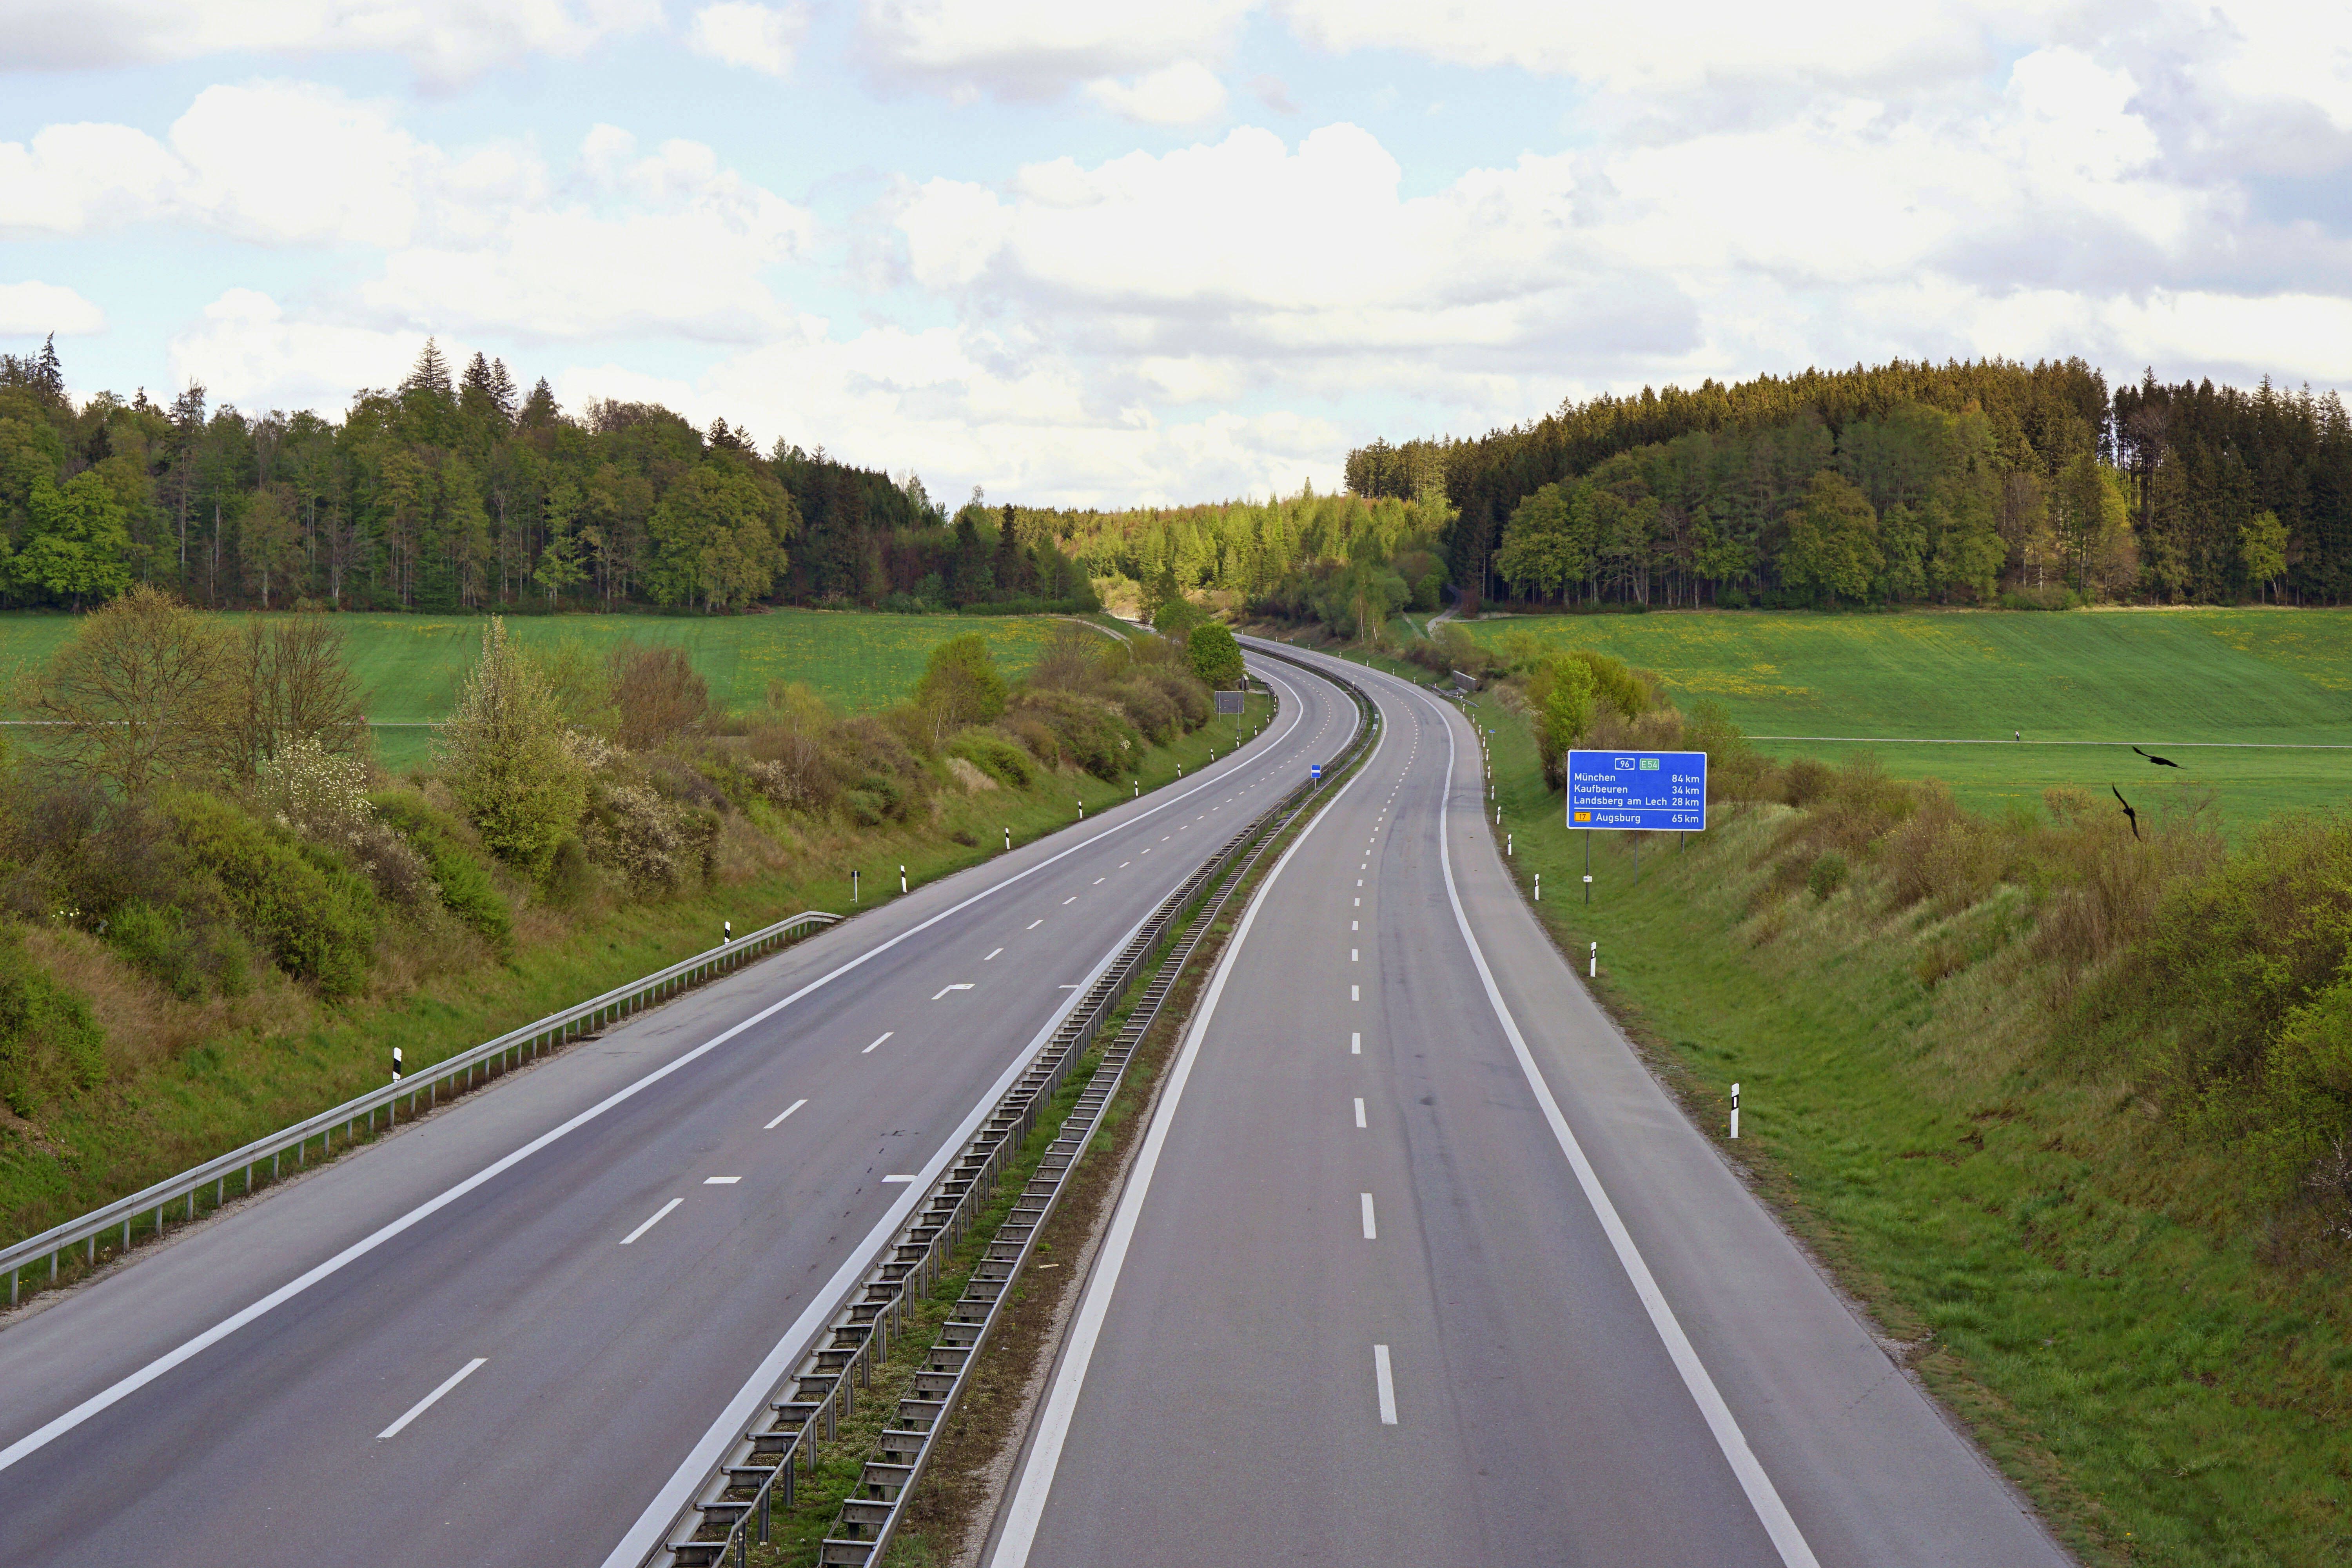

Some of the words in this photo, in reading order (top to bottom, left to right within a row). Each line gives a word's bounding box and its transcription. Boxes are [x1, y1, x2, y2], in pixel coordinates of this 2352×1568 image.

[1574, 773, 1615, 782] München
[1672, 774, 1683, 782] 84
[1686, 774, 1699, 783] km
[1574, 784, 1628, 793] Kaufbeuren
[1672, 786, 1683, 794] 34
[1686, 786, 1699, 795] km
[1574, 796, 1623, 806] Landsberg
[1646, 797, 1667, 806] Lech
[1672, 797, 1683, 806] 28
[1685, 798, 1699, 806] km
[1596, 813, 1641, 824] Augsburg
[1672, 814, 1682, 823] 65
[1685, 815, 1699, 823] km
